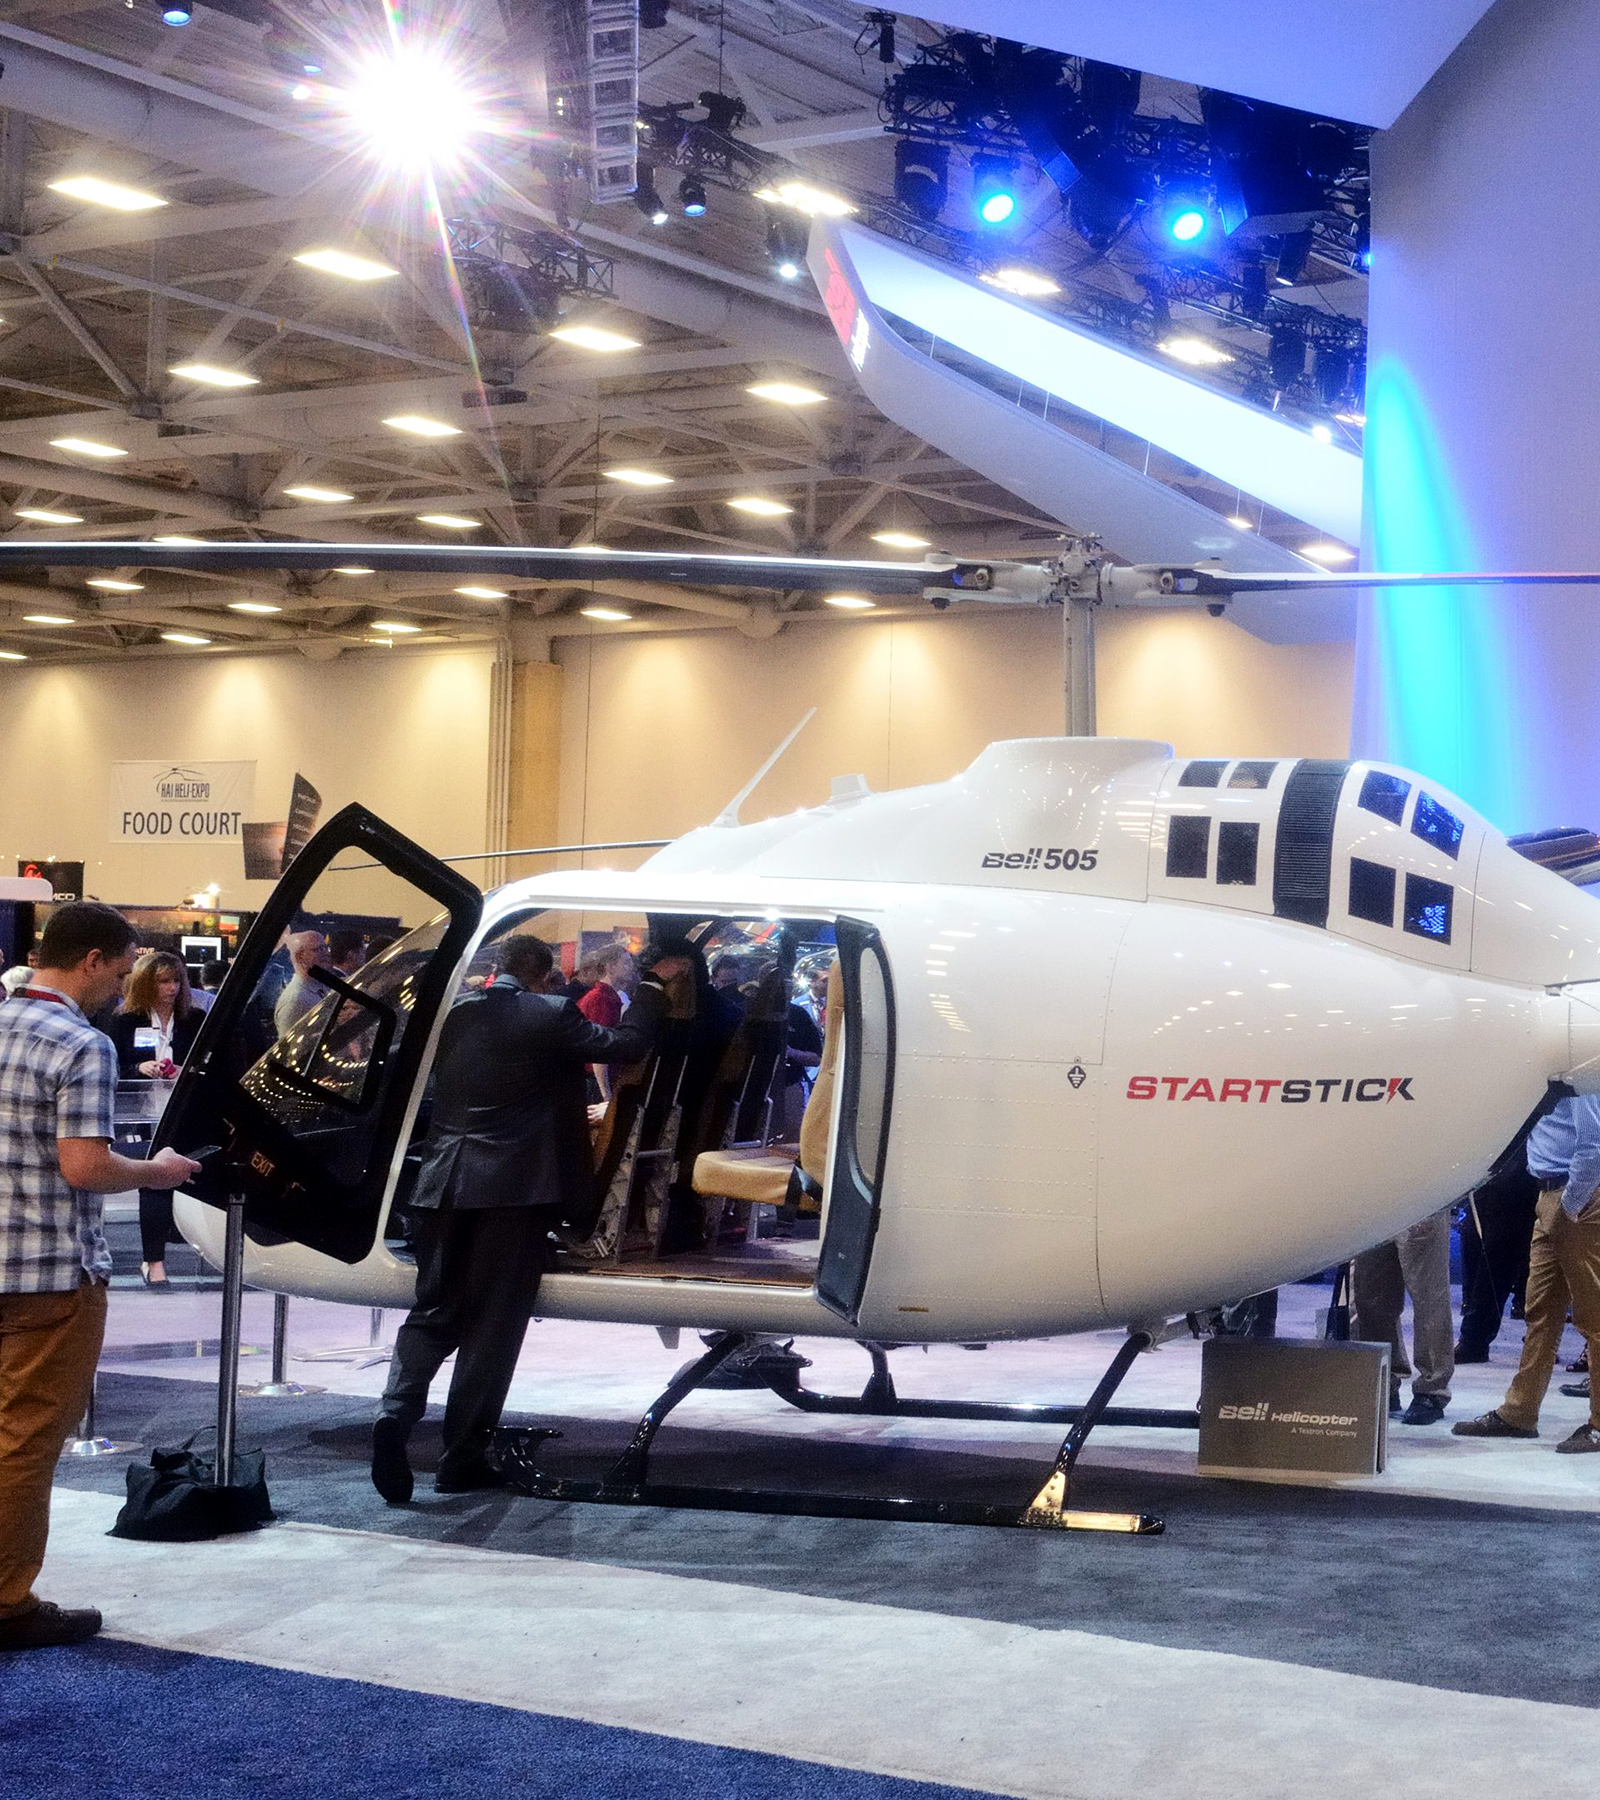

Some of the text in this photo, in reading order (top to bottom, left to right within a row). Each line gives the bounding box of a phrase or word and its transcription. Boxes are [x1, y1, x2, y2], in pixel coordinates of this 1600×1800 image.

[122, 812, 241, 835] FOOD COURT
[981, 848, 1099, 871] Bell 505
[1126, 1076, 1415, 1104] STARTSTICK
[251, 1151, 275, 1177] EXIT
[1218, 1402, 1358, 1427] Bell Helicopter
[1291, 1426, 1358, 1438] A Textron Company
